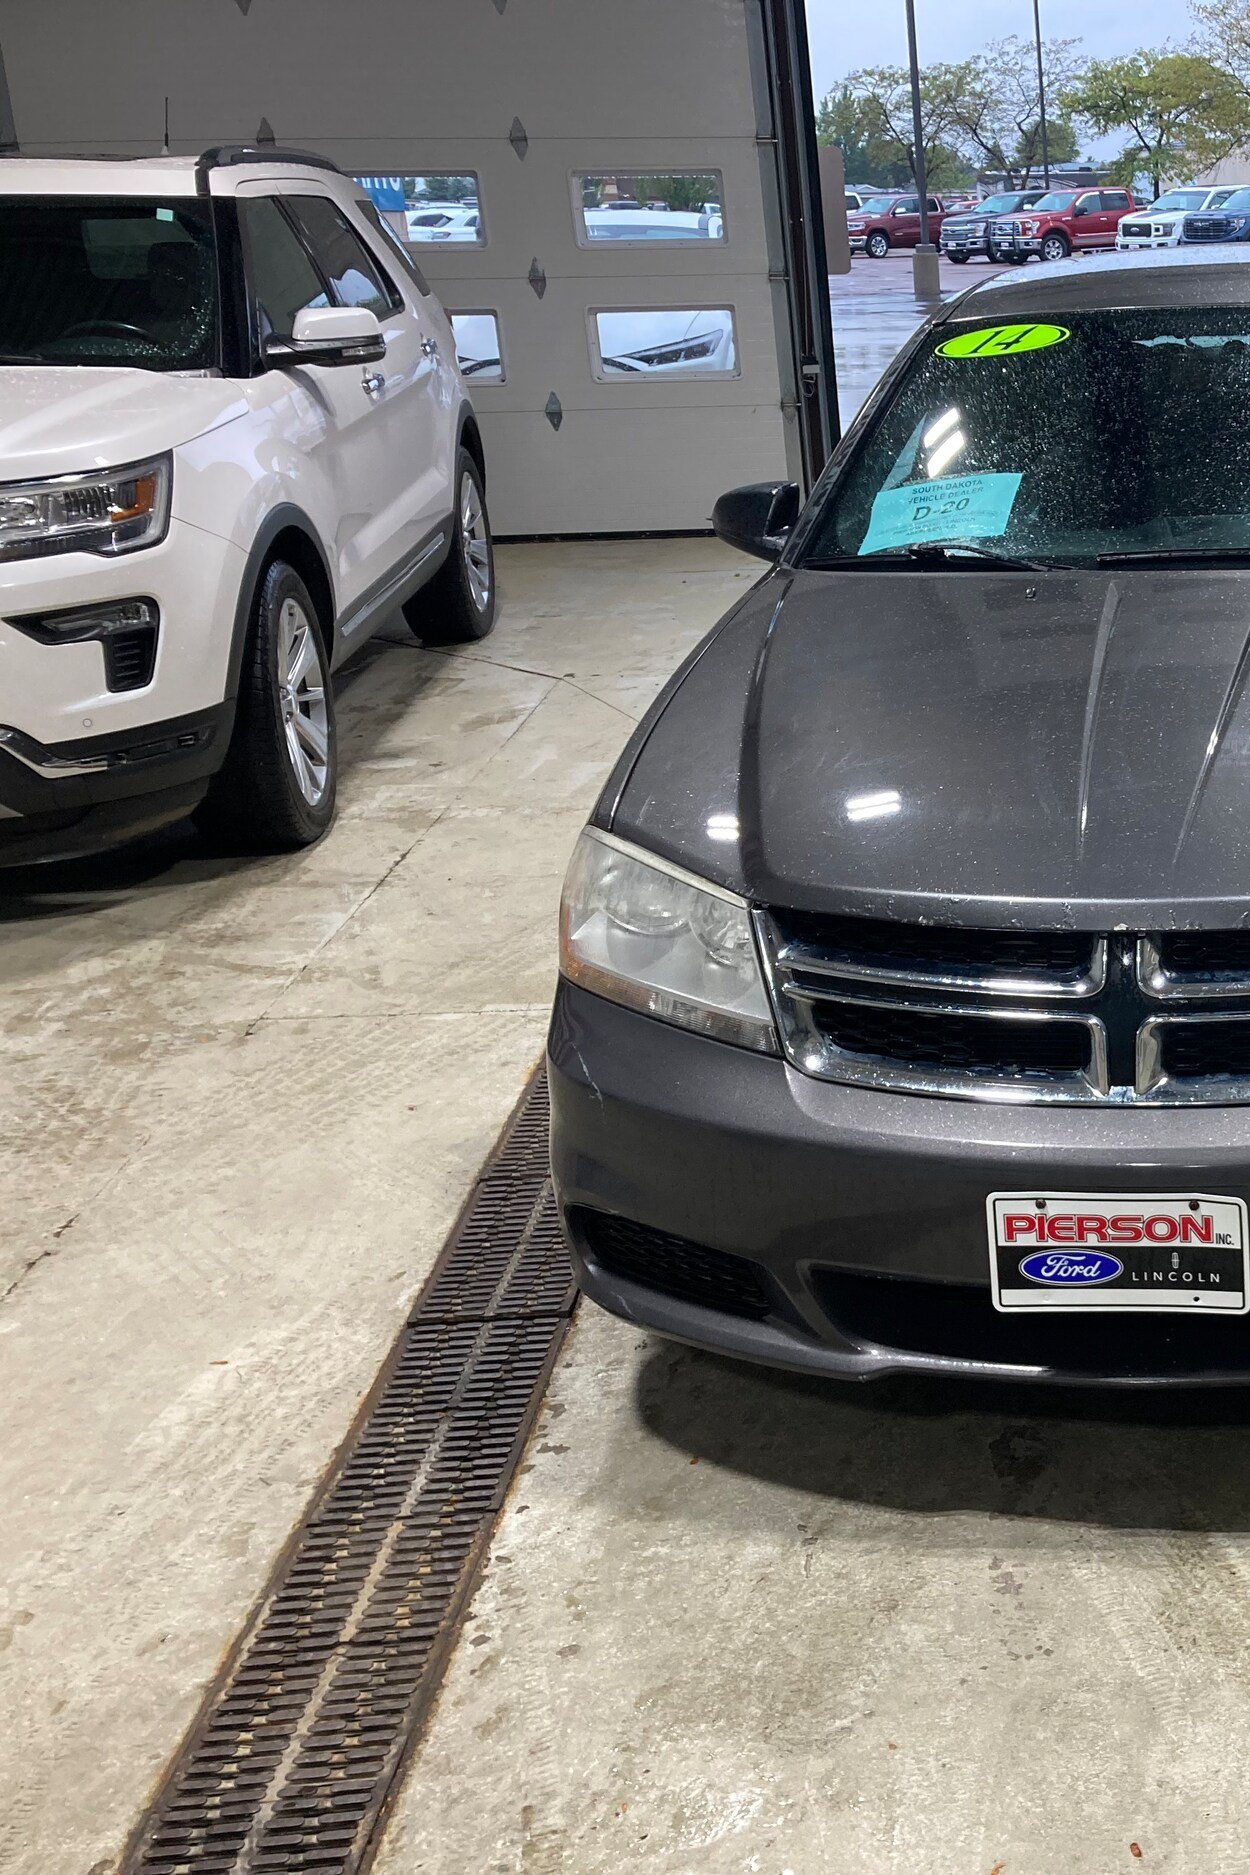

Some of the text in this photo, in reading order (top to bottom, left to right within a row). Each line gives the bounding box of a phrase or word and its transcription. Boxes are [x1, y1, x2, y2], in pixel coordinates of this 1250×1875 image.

[968, 325, 1039, 354] 14
[908, 486, 984, 505] VEHICLE DEALER
[912, 479, 983, 495] SOUTH DAKOTA
[912, 497, 970, 521] D-20
[1004, 1213, 1235, 1245] PIERSON INC.
[1041, 1254, 1102, 1278] Ford
[1132, 1271, 1221, 1283] LINCOLN
